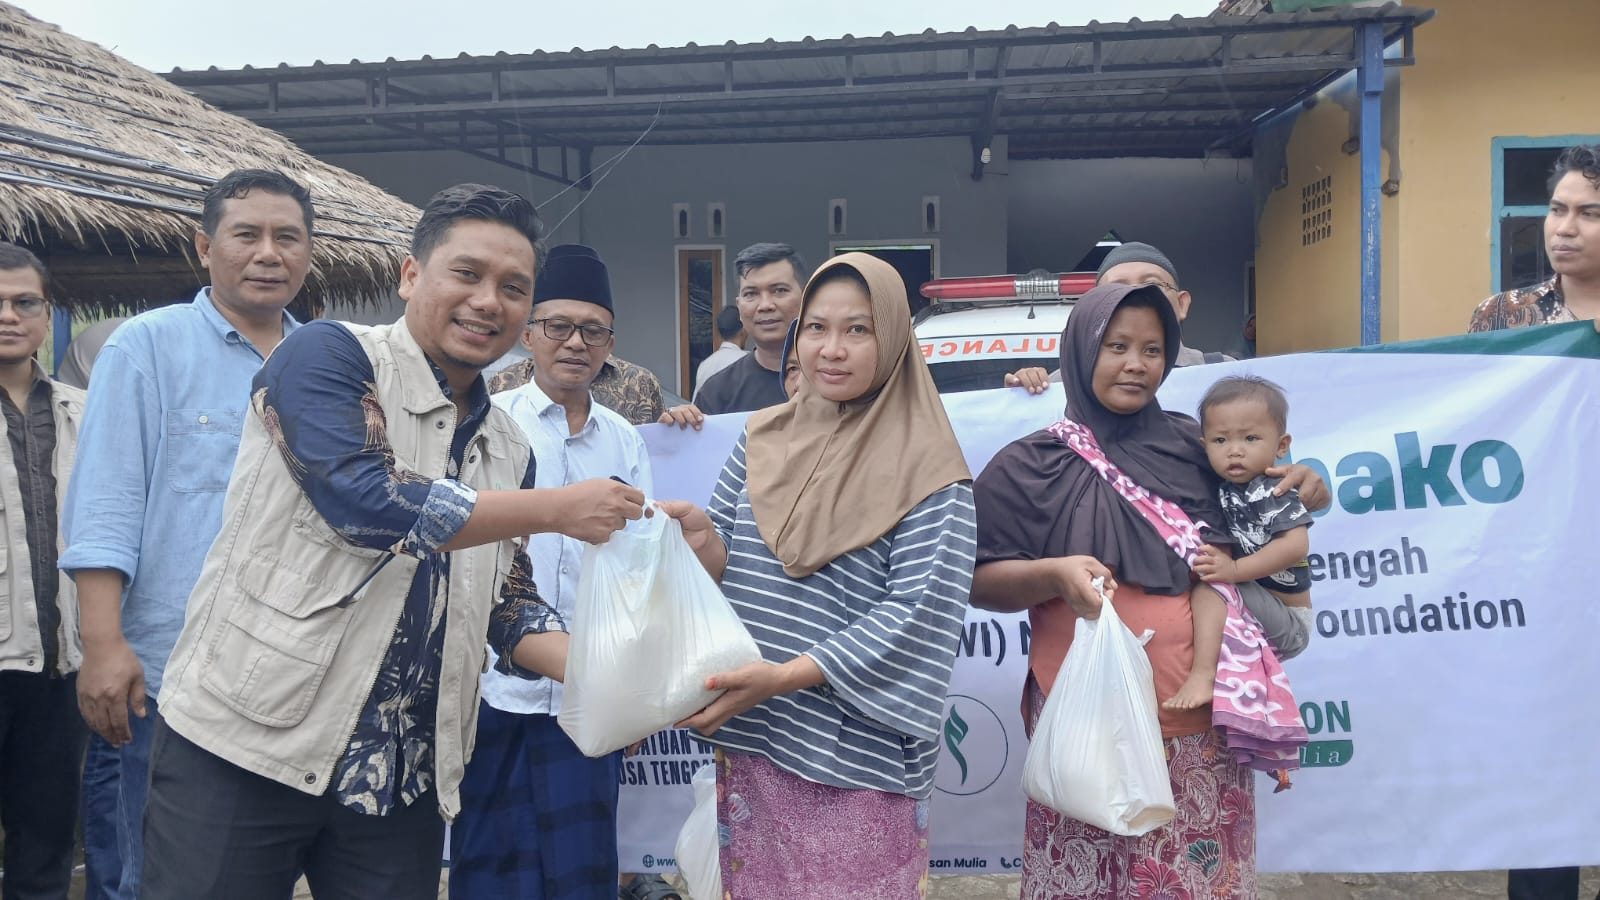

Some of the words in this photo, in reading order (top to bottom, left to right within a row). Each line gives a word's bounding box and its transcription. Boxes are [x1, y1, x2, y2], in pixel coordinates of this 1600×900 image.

[1308, 536, 1429, 588] engah
[1315, 591, 1527, 638] oundation
[1299, 700, 1352, 734] ON
[954, 856, 987, 868] Mulia
